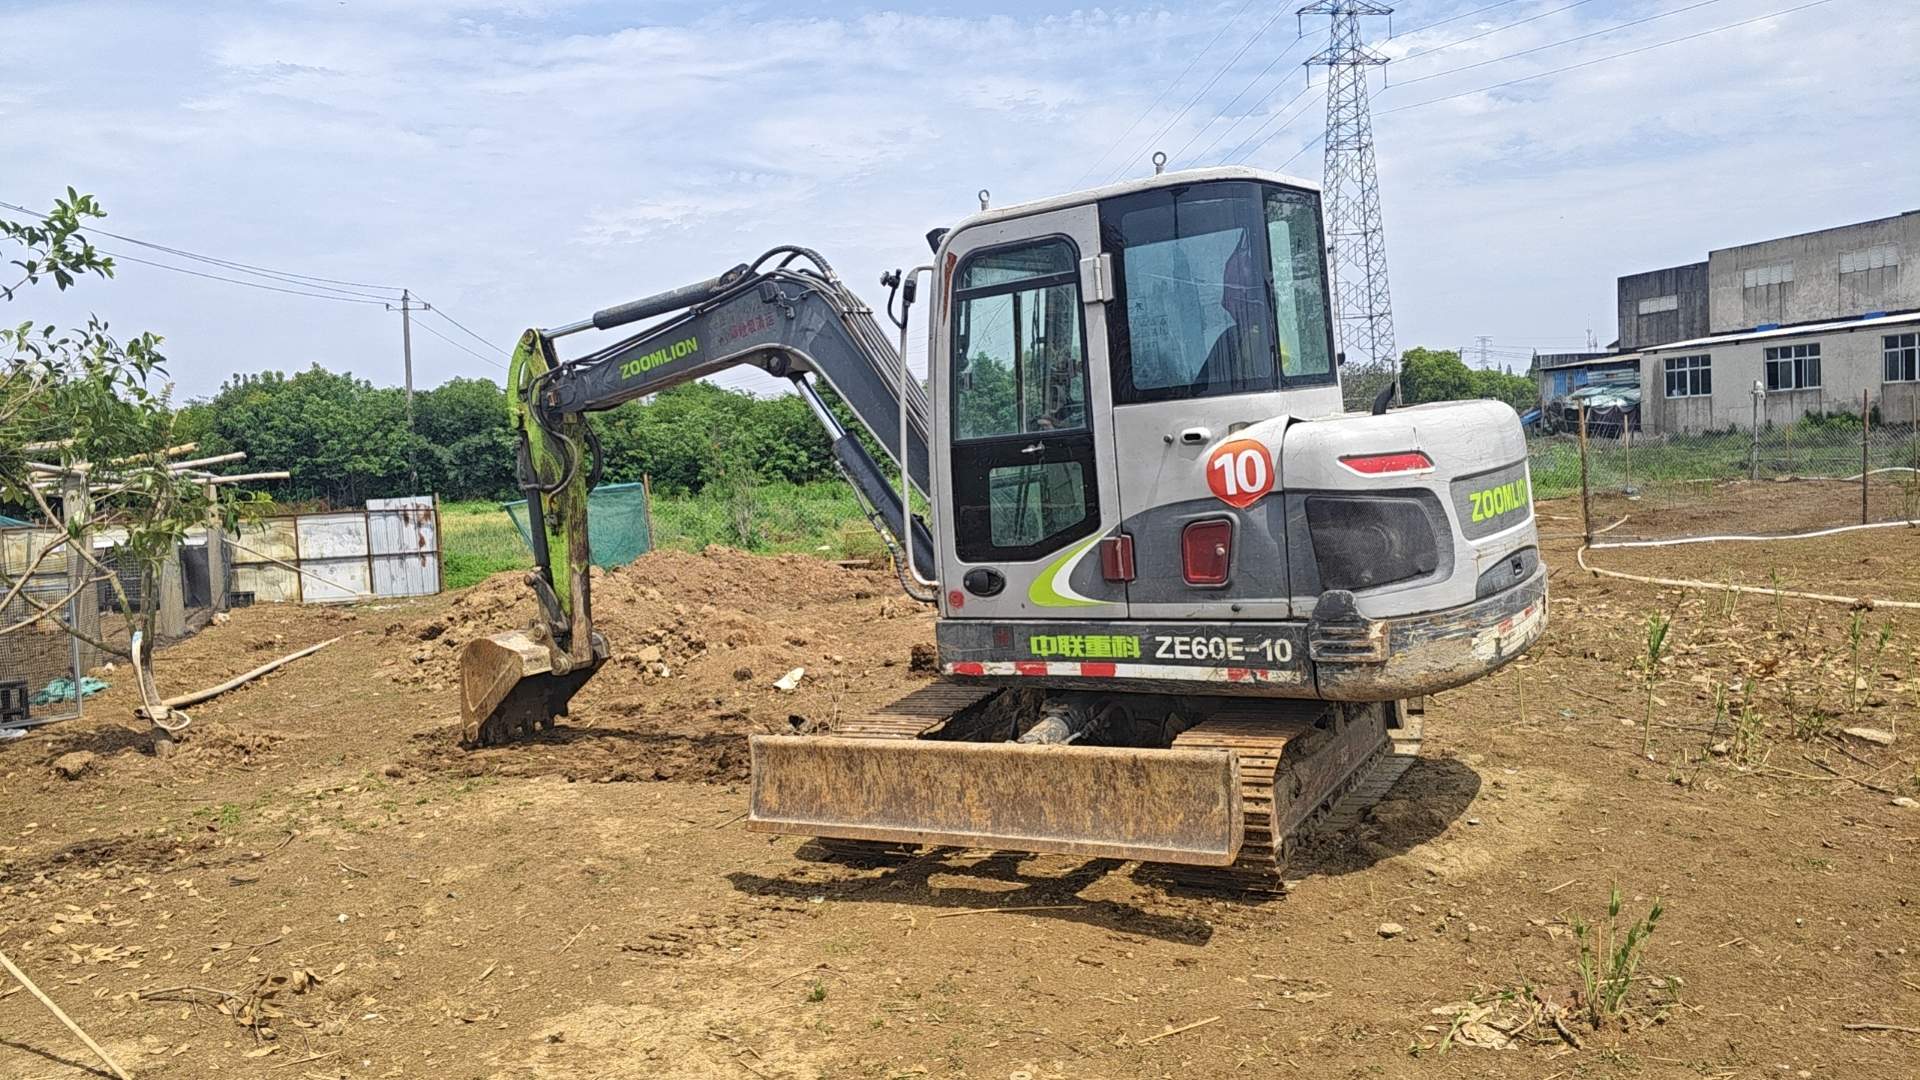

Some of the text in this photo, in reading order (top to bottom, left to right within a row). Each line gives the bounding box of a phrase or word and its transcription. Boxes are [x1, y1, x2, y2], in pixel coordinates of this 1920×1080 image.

[619, 336, 698, 380] ZOOMLION
[1213, 449, 1267, 495] 10
[1470, 478, 1527, 523] ZOOMLIO
[1029, 635, 1294, 662] 中联重科 ZE60E-10
